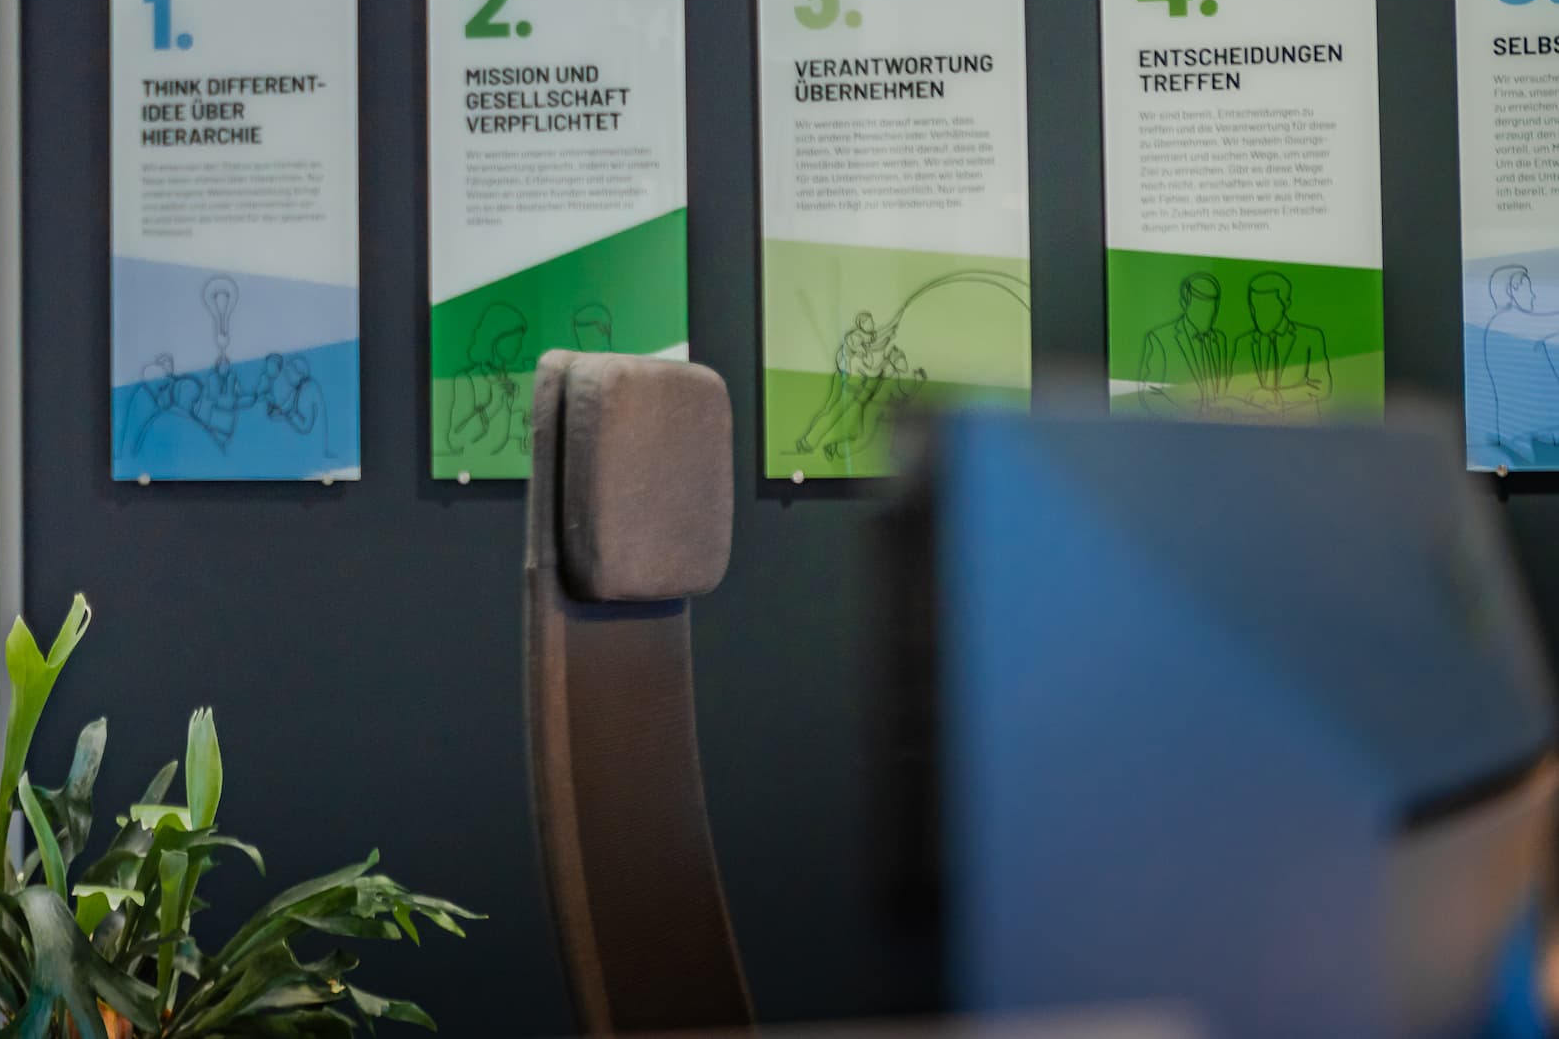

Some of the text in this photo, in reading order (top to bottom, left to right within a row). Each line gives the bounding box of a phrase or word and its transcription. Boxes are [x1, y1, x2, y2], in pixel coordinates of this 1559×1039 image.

[794, 54, 994, 78] VERANTWORTUNG
[1139, 44, 1343, 68] ENTSCHEIDUNGEN
[142, 74, 327, 98] THINK DIFFERENT-
[465, 65, 599, 86] MISSION UND
[1140, 72, 1241, 93] TREFFEN
[465, 88, 630, 110] GESELLSCHAFT
[795, 79, 945, 102] ÜBERNEHMEN
[142, 98, 245, 123] IDEE ÜBER
[466, 112, 622, 134] VERPFLICHTET
[142, 126, 262, 147] HIERARCHIE
